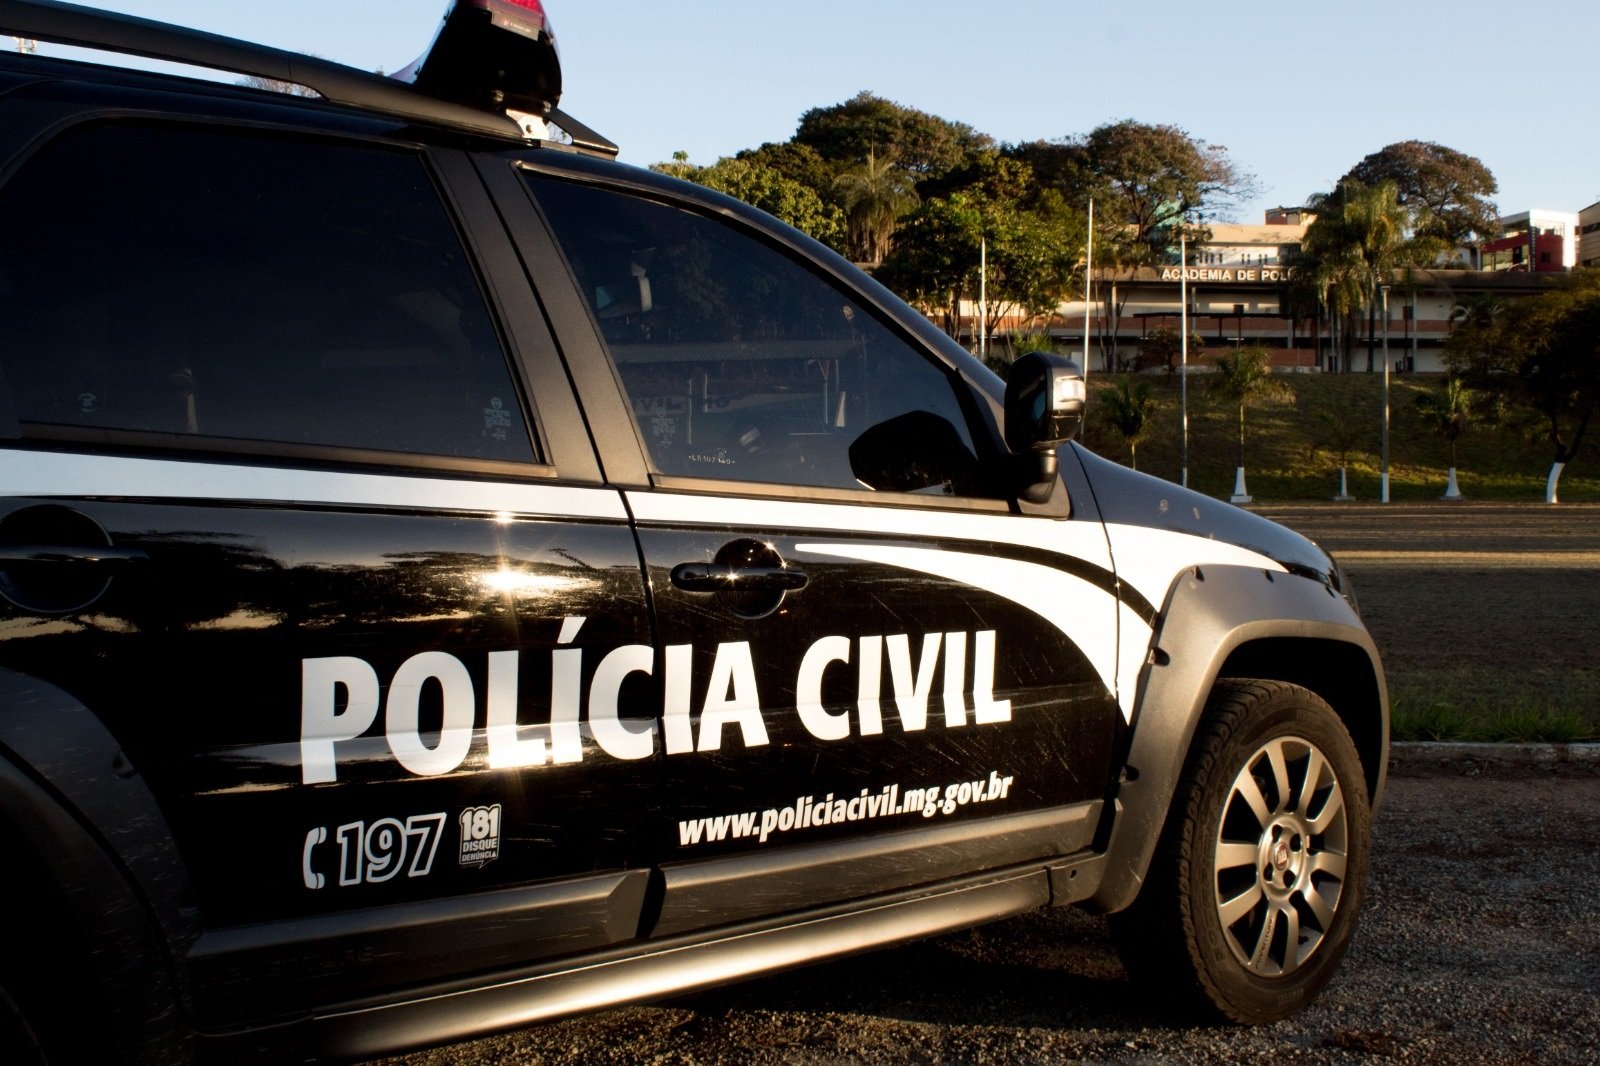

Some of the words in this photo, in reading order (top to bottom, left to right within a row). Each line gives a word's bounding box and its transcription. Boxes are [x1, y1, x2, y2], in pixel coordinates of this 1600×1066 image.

[1162, 268, 1232, 280] ACADEMIA
[1238, 269, 1256, 280] DE
[1261, 269, 1290, 281] POL
[301, 616, 769, 785] POLÍCIA
[796, 630, 1012, 742] CIVIL
[462, 807, 499, 841] 181
[678, 770, 1014, 846] www.policiacivil.mg.gov.br
[336, 812, 447, 887] 197
[462, 838, 498, 853] DISQUE
